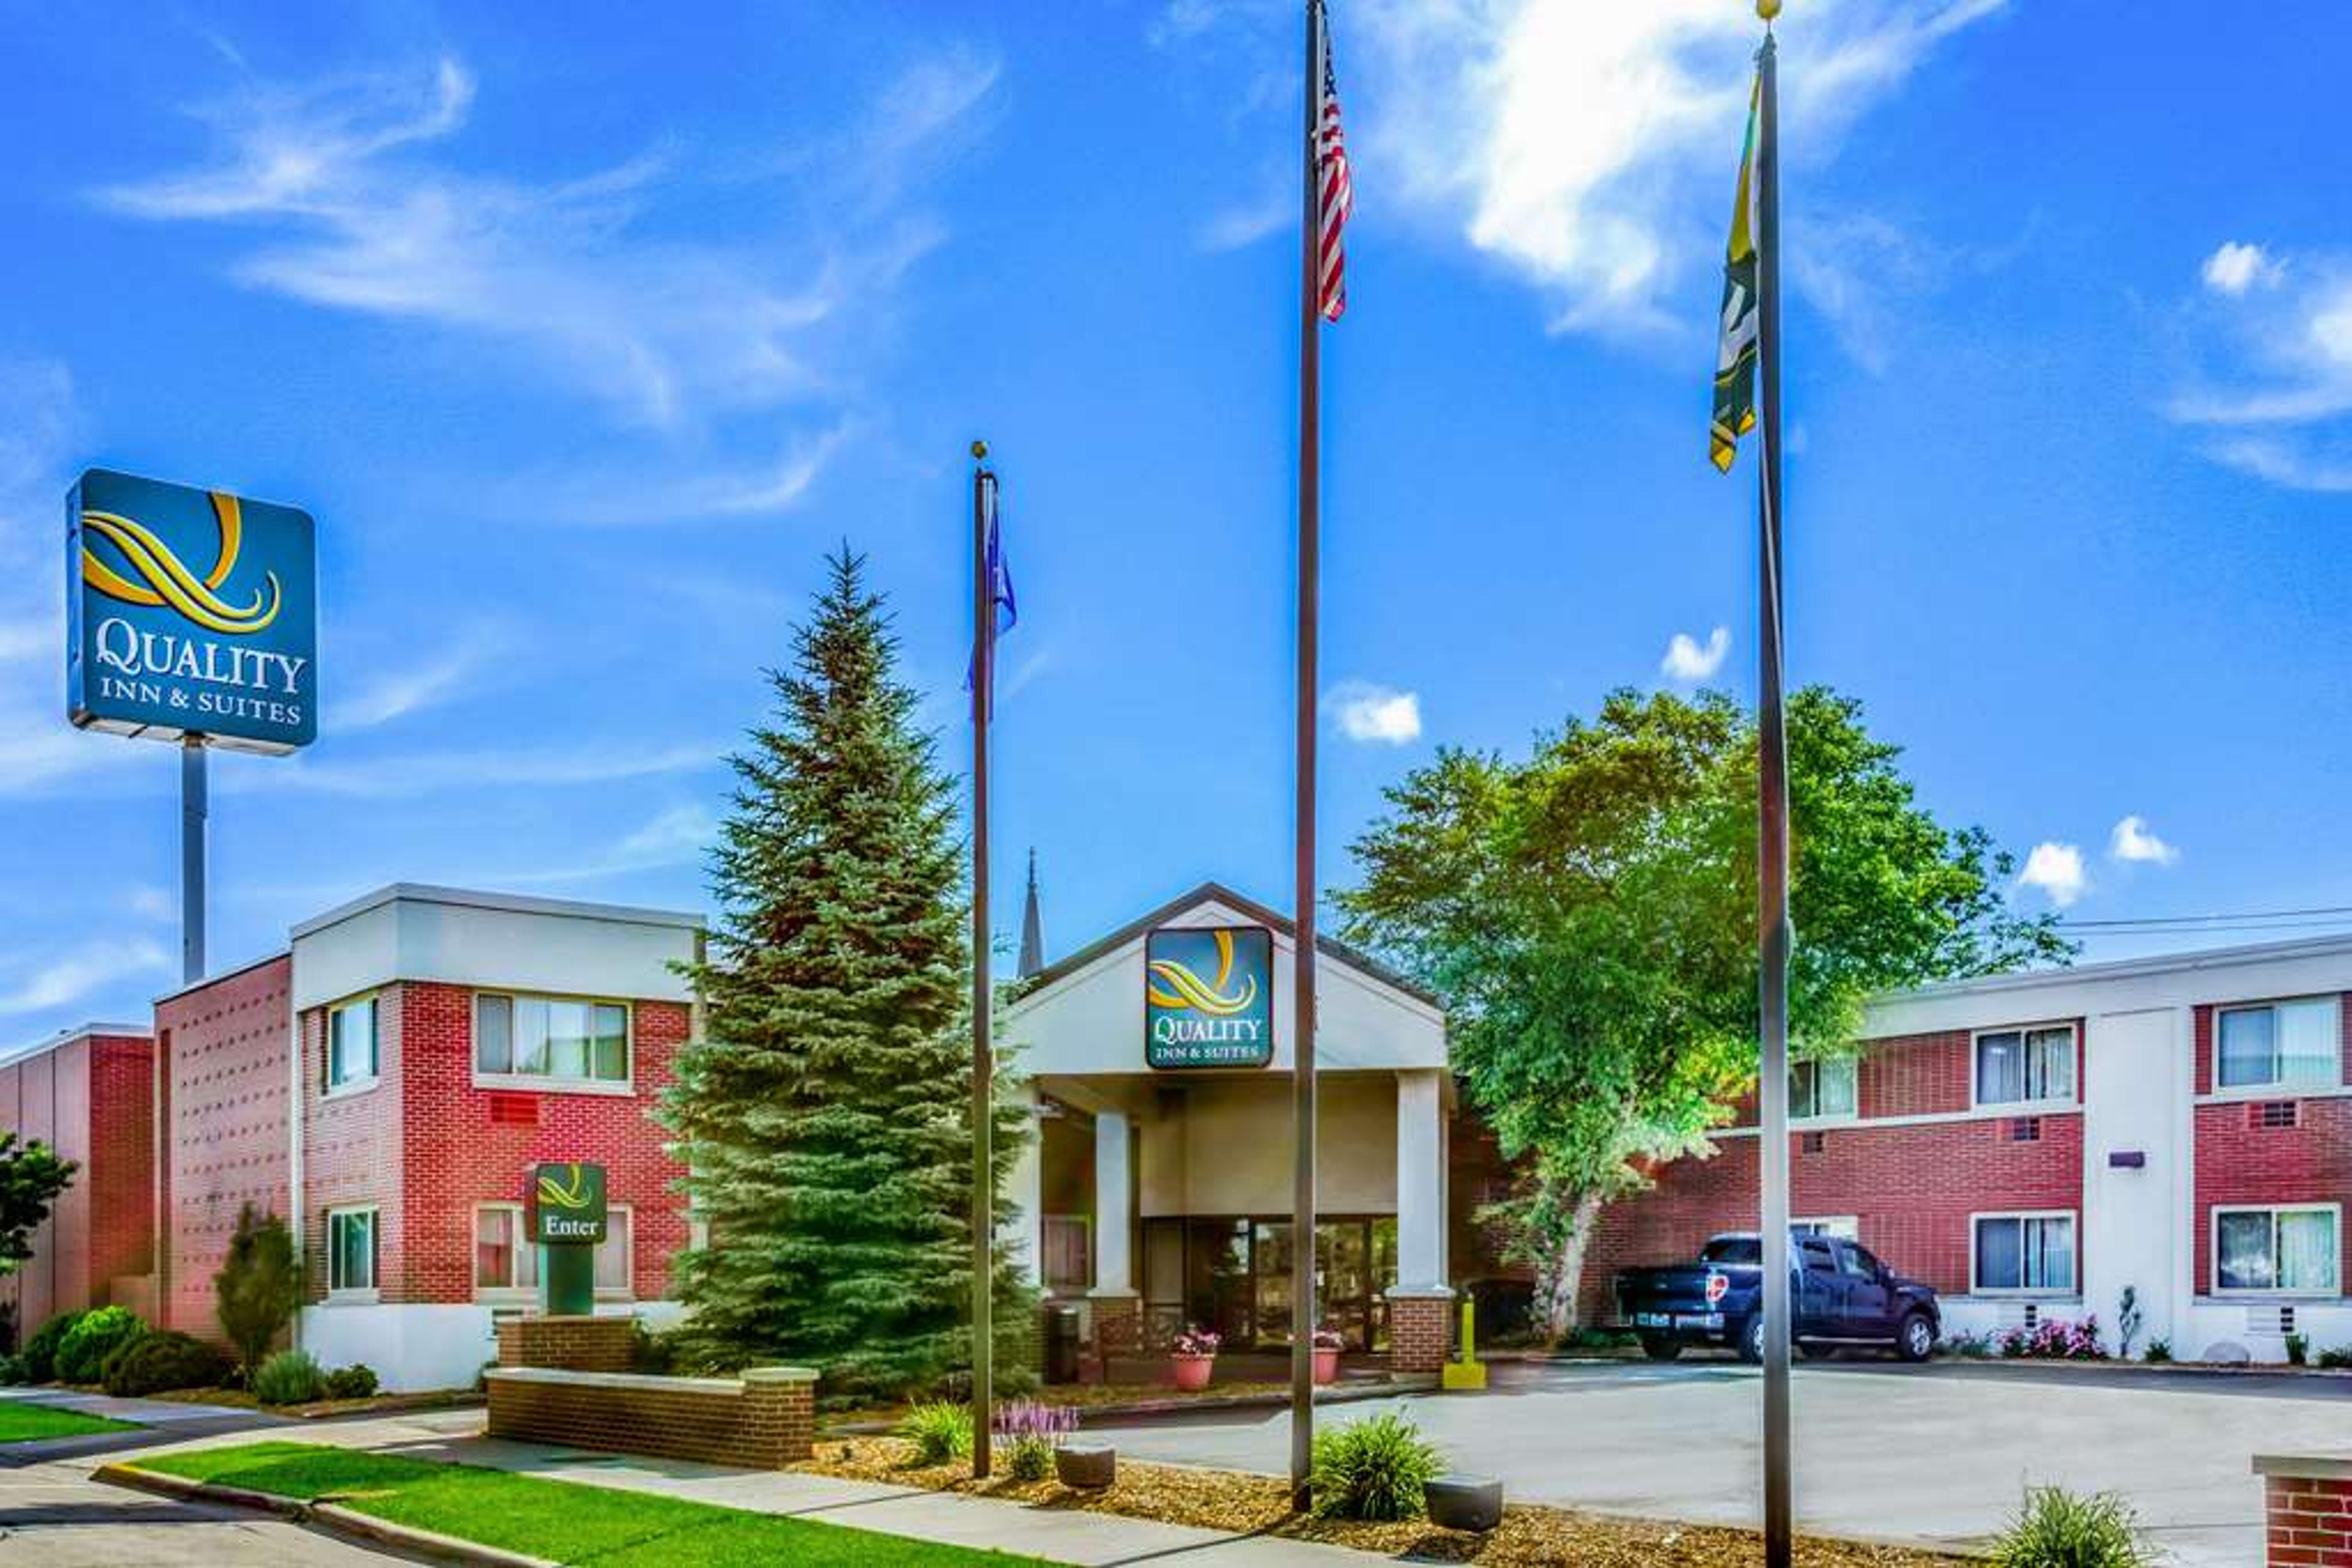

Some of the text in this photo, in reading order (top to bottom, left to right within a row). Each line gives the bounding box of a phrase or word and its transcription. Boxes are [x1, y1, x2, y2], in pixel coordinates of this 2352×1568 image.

[96, 617, 306, 694] QUALITY
[102, 677, 302, 726] INN & SUITES
[1155, 1016, 1261, 1044] QUALITY
[1156, 1046, 1259, 1058] INN & SUITES
[546, 1215, 598, 1235] Enter
